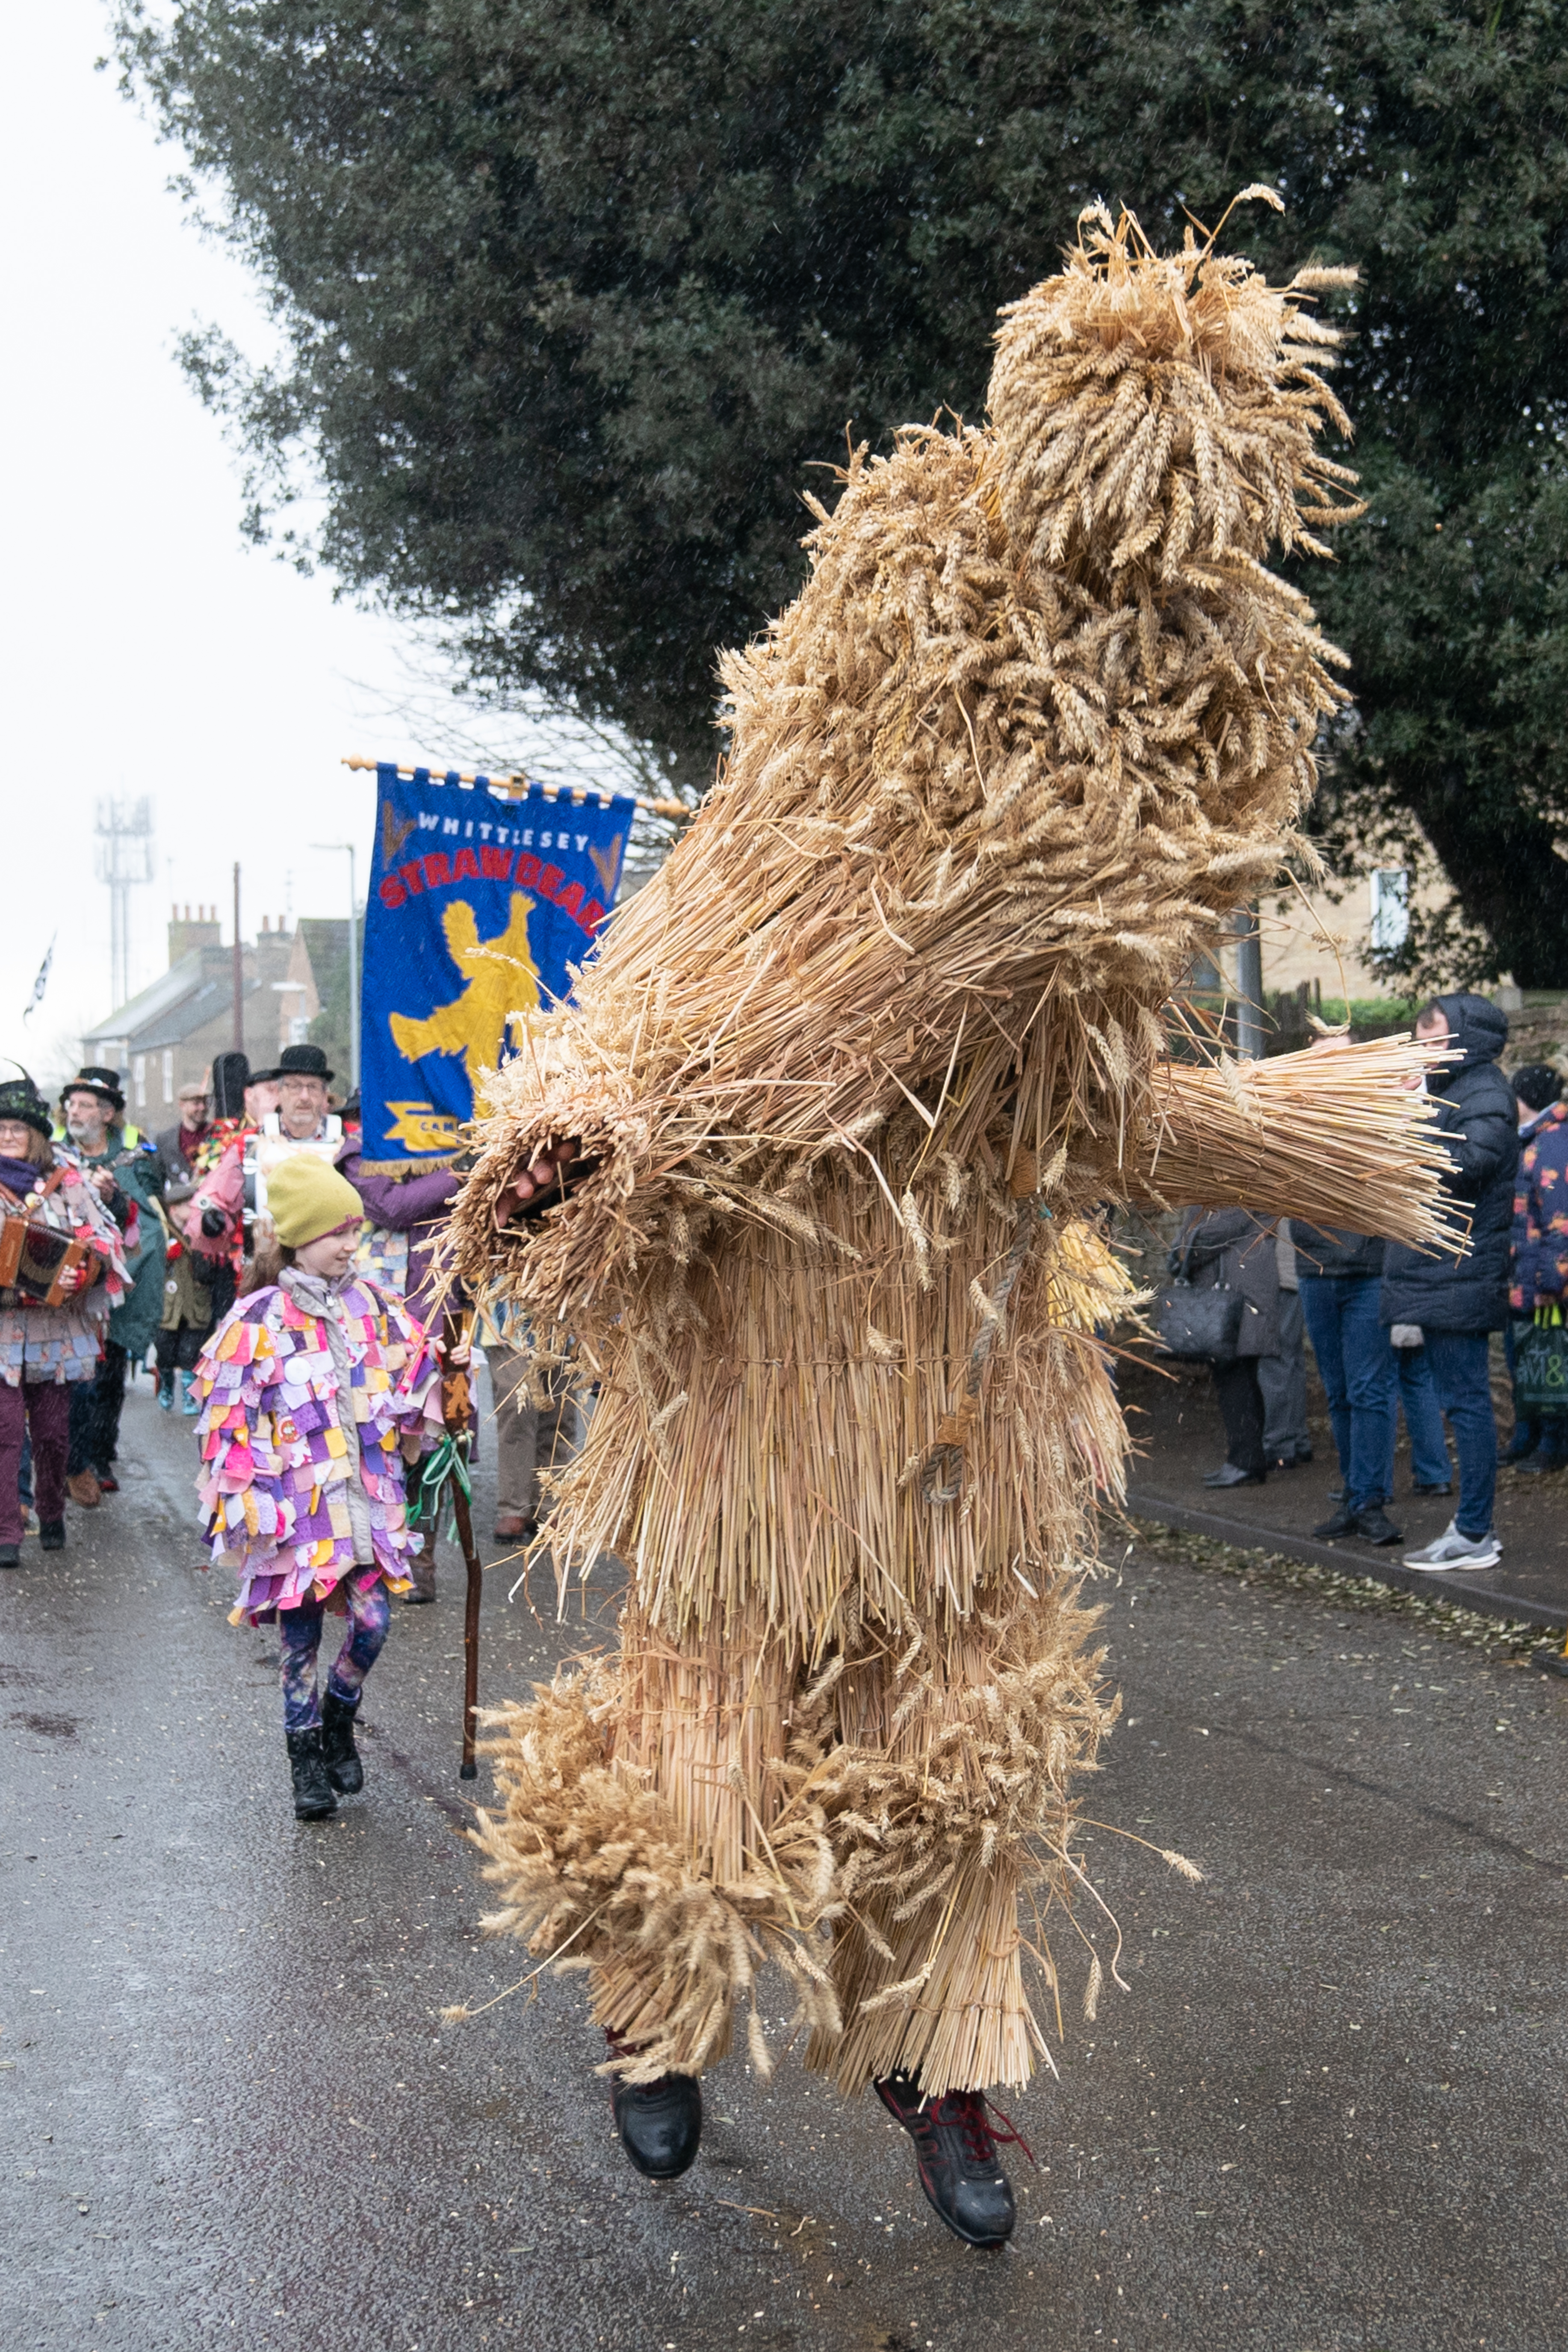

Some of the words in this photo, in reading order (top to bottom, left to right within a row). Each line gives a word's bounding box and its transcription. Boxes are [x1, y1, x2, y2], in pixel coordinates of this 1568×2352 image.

[419, 812, 589, 851] WHITTLESEY
[380, 845, 514, 908] STRAW
[515, 852, 605, 938] BEAR
